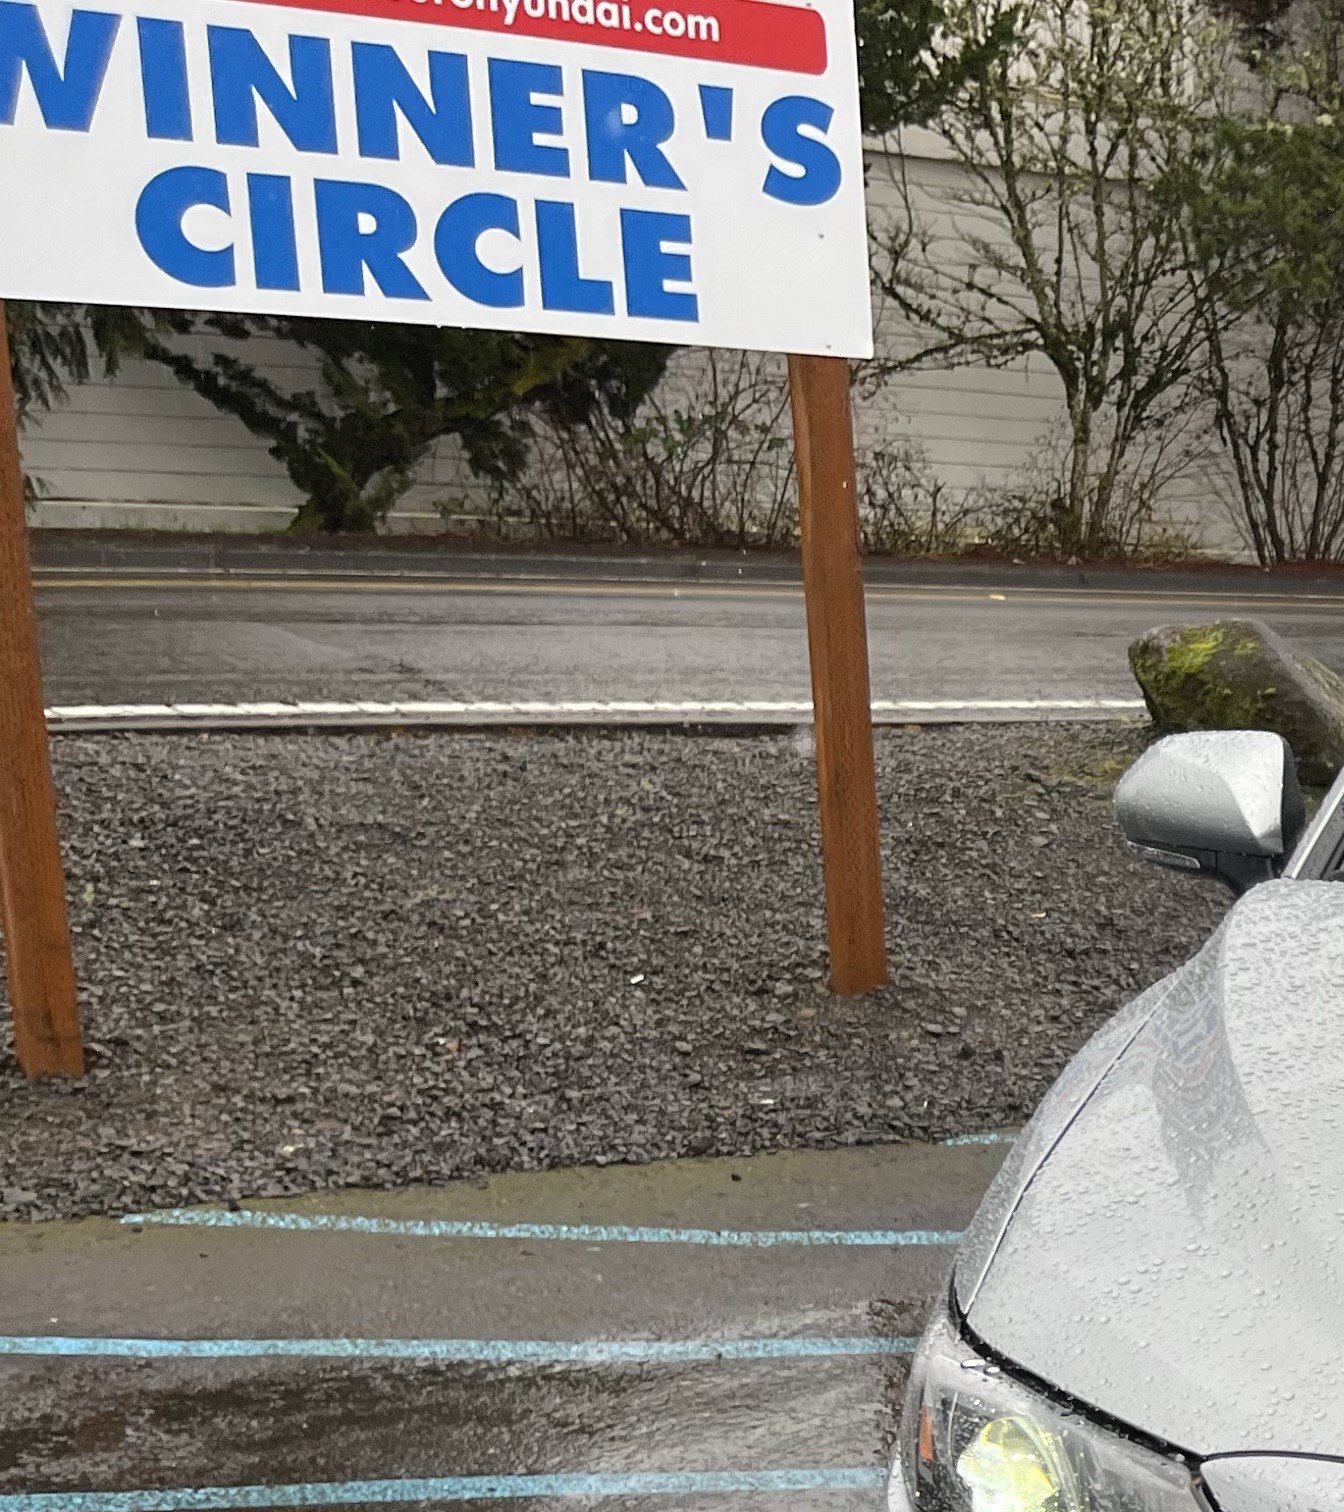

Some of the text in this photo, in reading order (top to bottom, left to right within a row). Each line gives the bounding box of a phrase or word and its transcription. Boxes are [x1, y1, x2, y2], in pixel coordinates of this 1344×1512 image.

[410, 0, 721, 42] yundai.com
[0, 1, 843, 207] WINNER'S
[135, 165, 701, 323] CIRCLE
